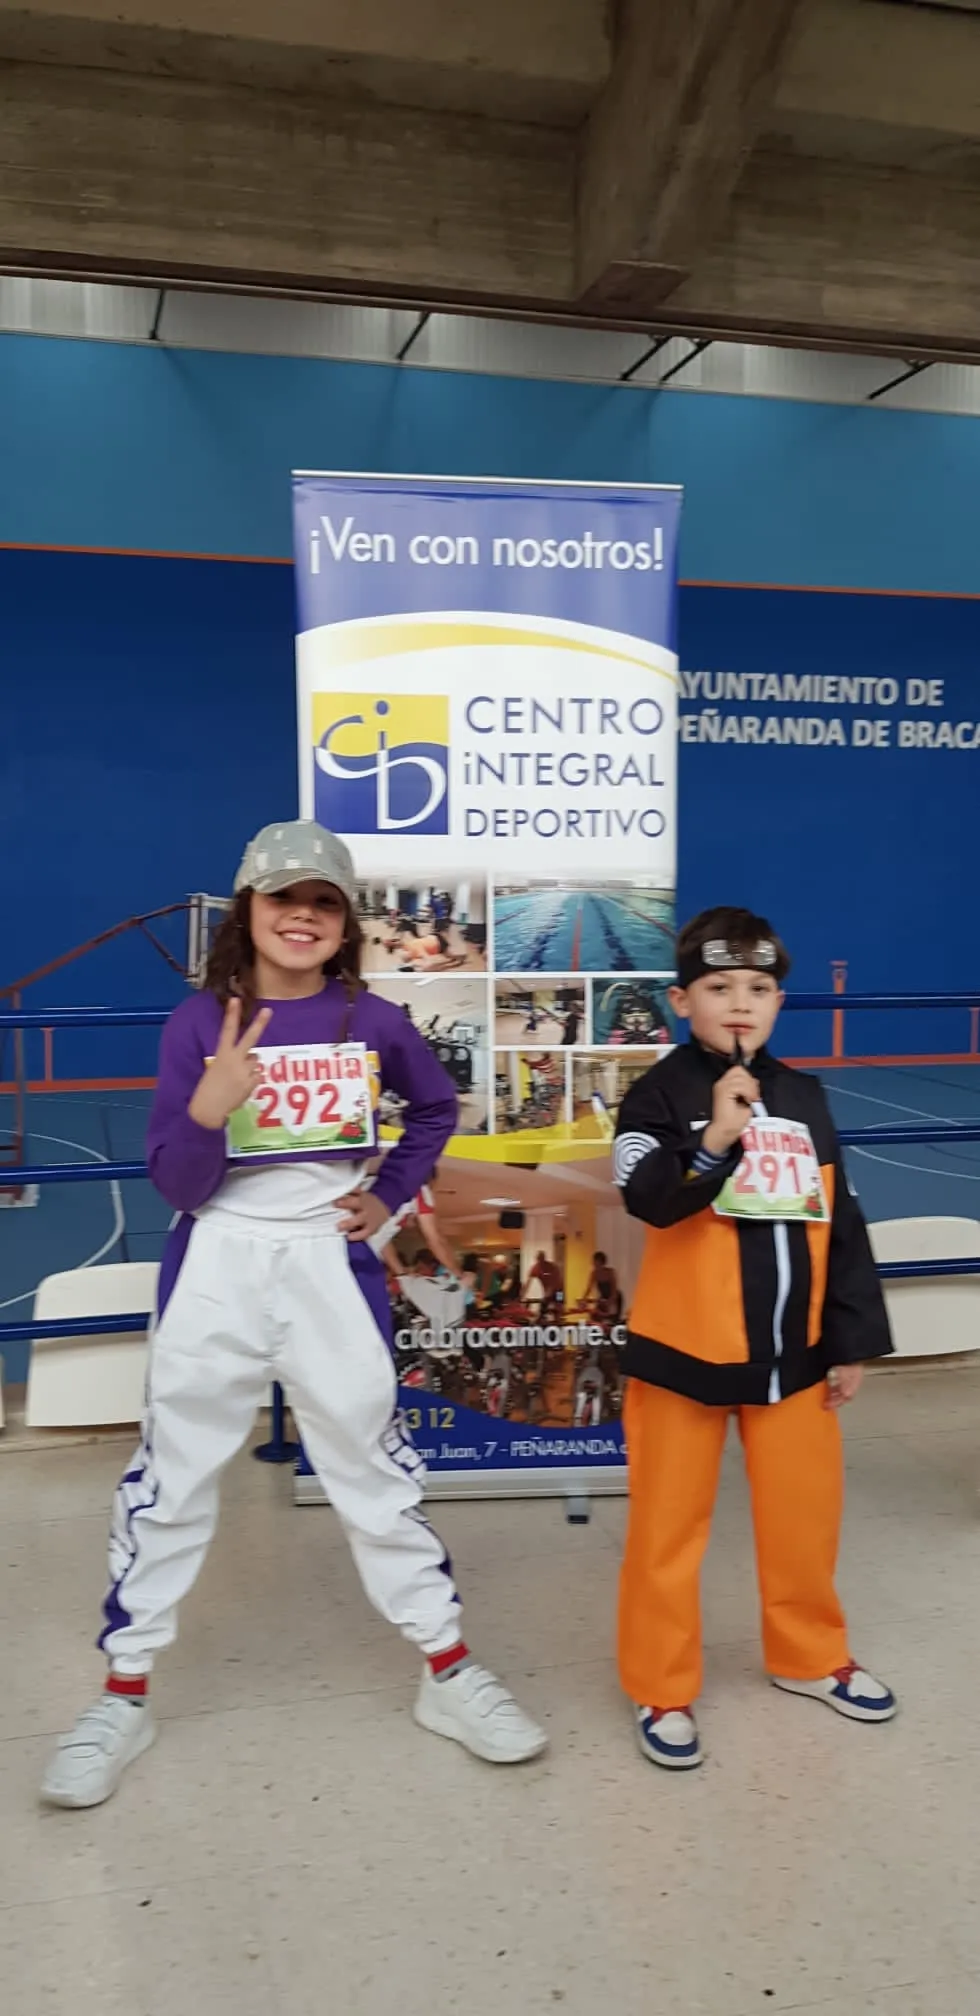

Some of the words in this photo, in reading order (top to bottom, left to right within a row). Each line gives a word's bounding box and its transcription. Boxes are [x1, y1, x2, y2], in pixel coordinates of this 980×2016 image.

[310, 516, 395, 574] ¡Ven
[409, 535, 479, 566] con
[493, 527, 664, 571] nosotros!
[906, 679, 944, 706] DE
[465, 696, 664, 735] CENTRO
[678, 708, 847, 746] EÑARANDA
[852, 719, 891, 748] DE
[464, 808, 666, 838] DEPORTIVO
[256, 1083, 342, 1128] 292
[735, 1154, 802, 1194] 291
[427, 1407, 455, 1429] 12
[483, 1441, 498, 1458] 7
